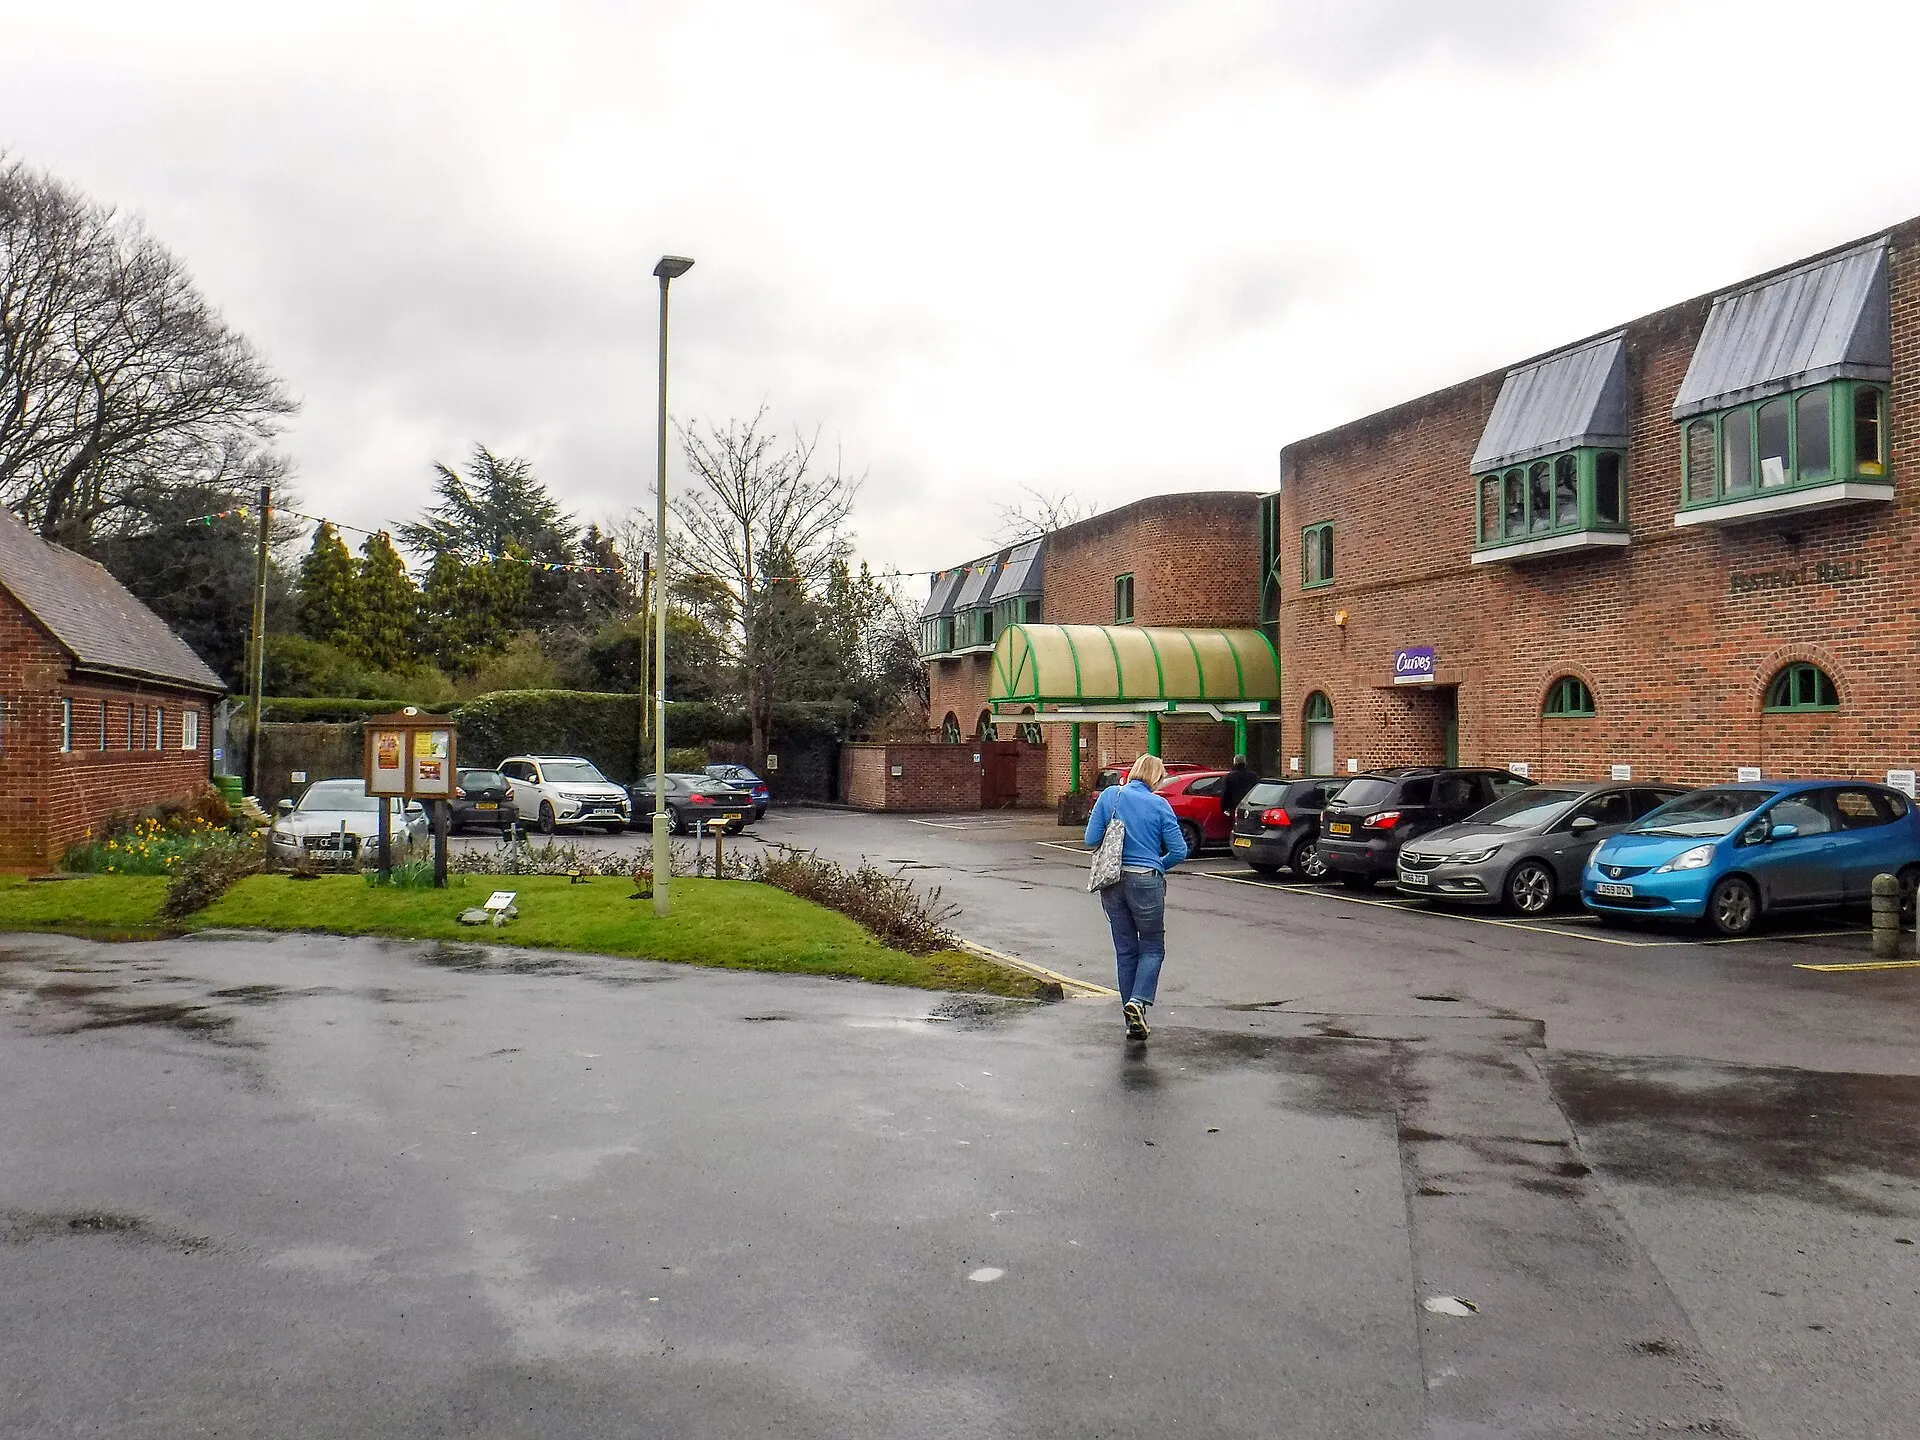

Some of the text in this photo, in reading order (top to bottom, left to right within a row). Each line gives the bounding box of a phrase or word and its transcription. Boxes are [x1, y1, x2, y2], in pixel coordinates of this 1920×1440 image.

[1816, 560, 1867, 583] HALL
[1396, 652, 1430, 672] Curves
[1616, 885, 1631, 896] DZN
